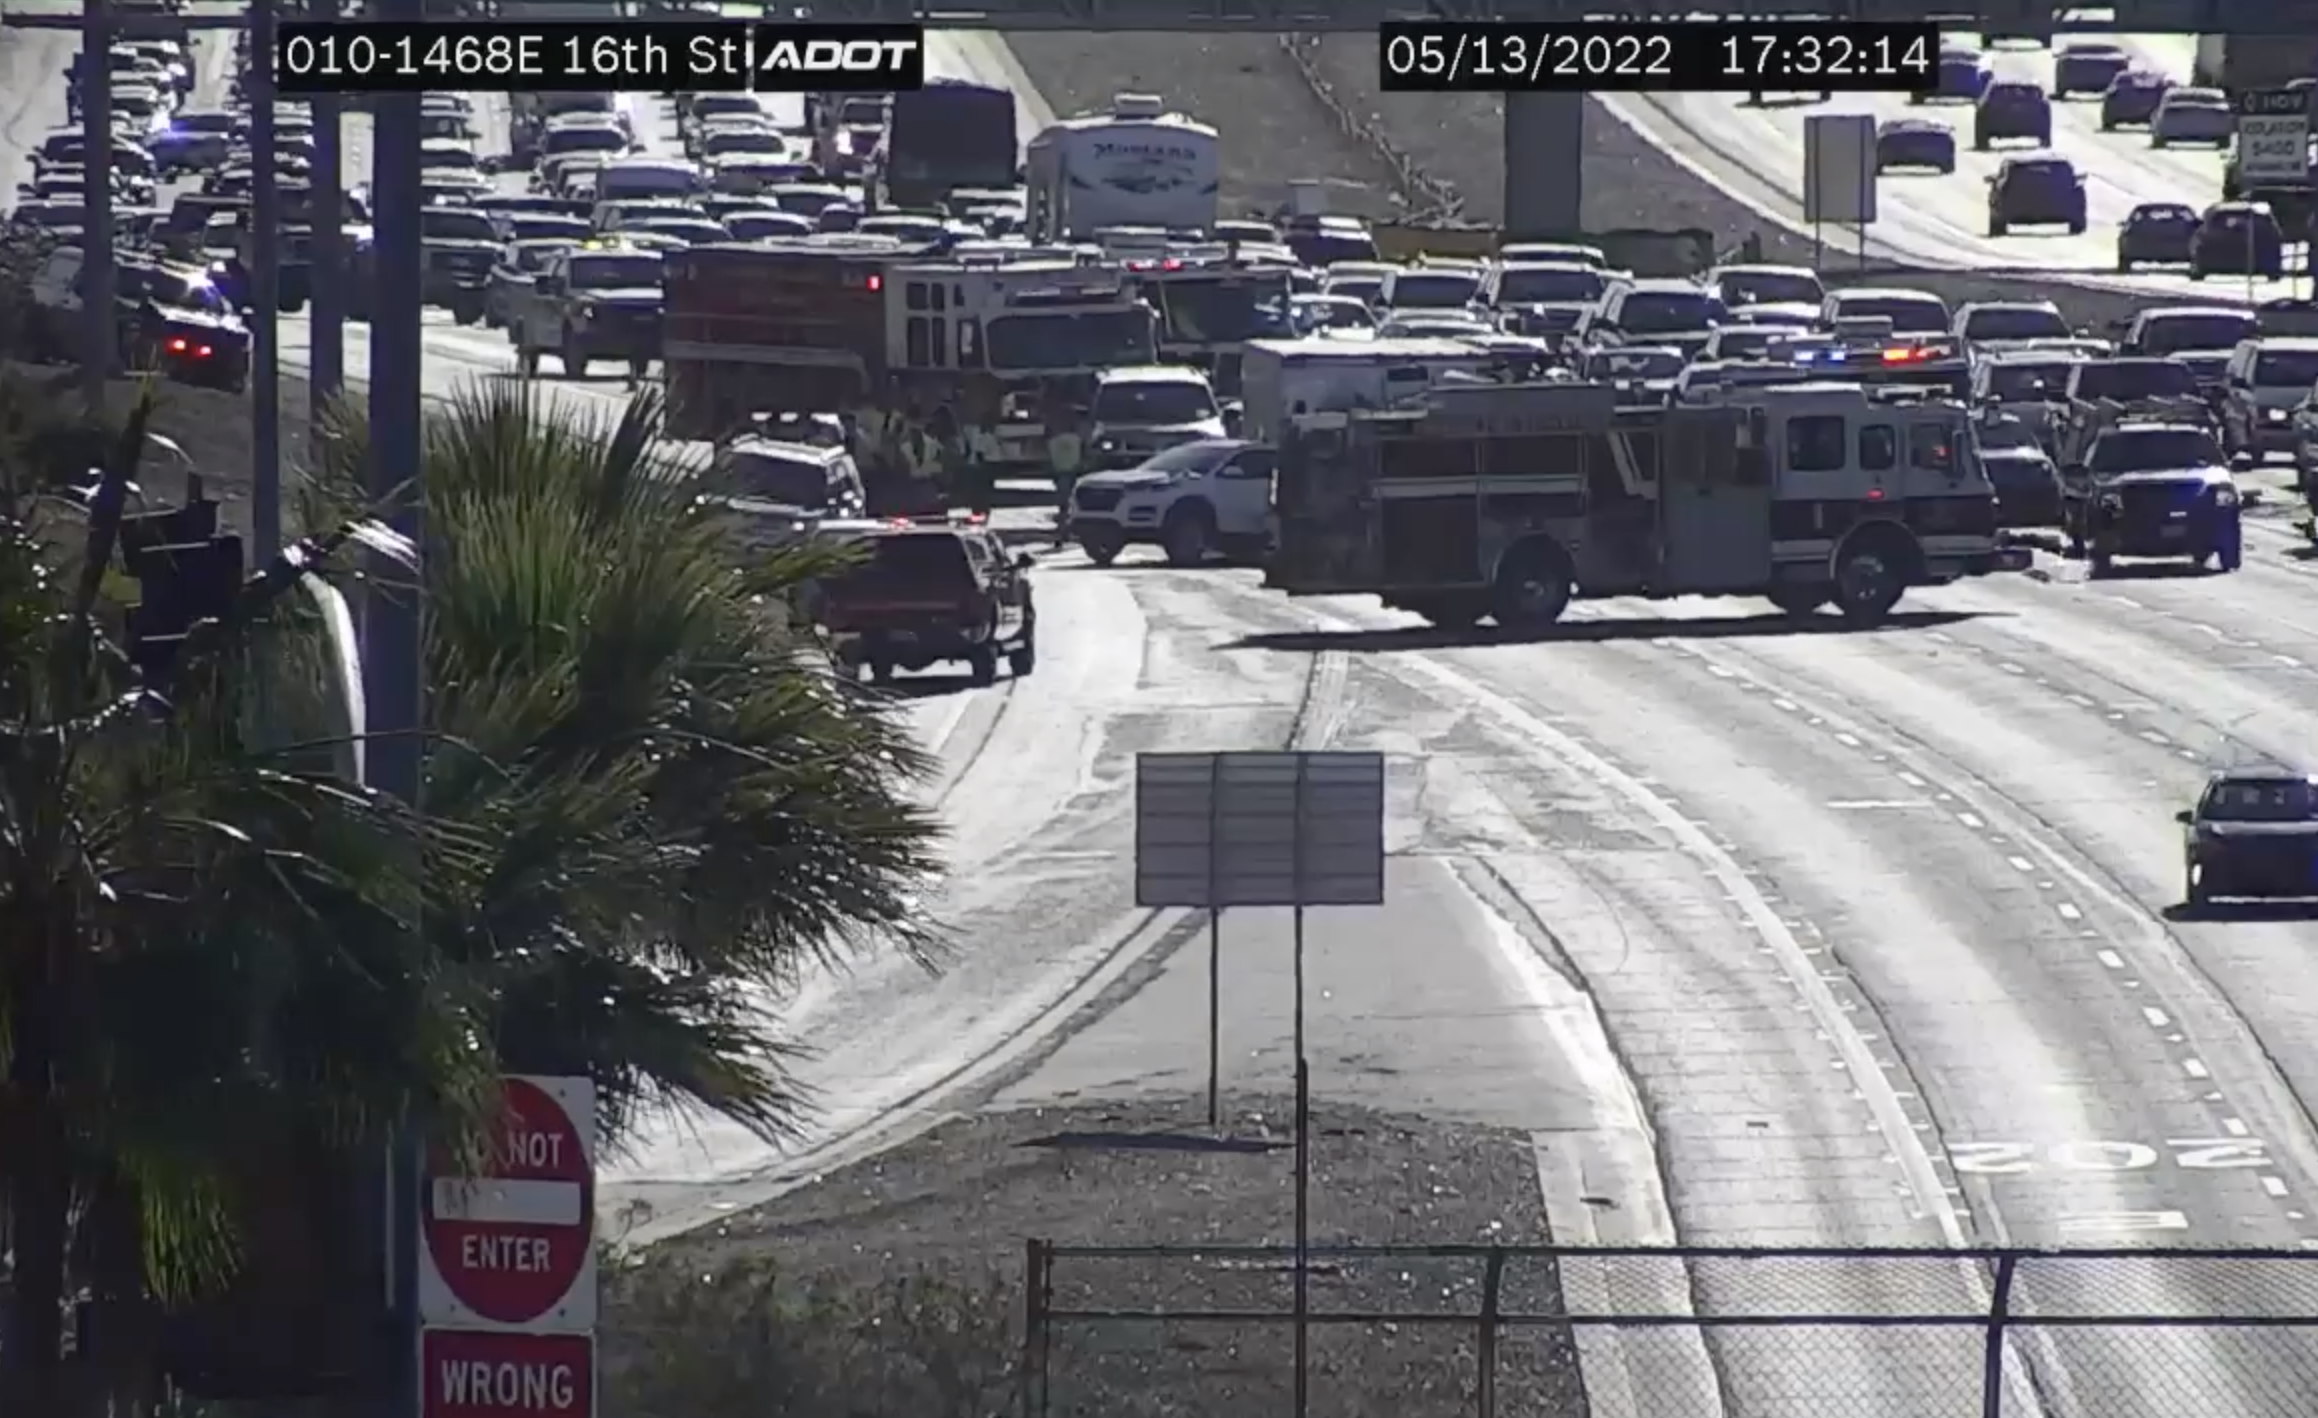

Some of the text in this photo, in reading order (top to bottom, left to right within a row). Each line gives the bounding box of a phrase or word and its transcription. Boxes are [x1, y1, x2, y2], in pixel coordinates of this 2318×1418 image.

[506, 1132, 563, 1169] NOT
[461, 1233, 552, 1273] ENTER
[440, 1358, 574, 1410] WRONG
